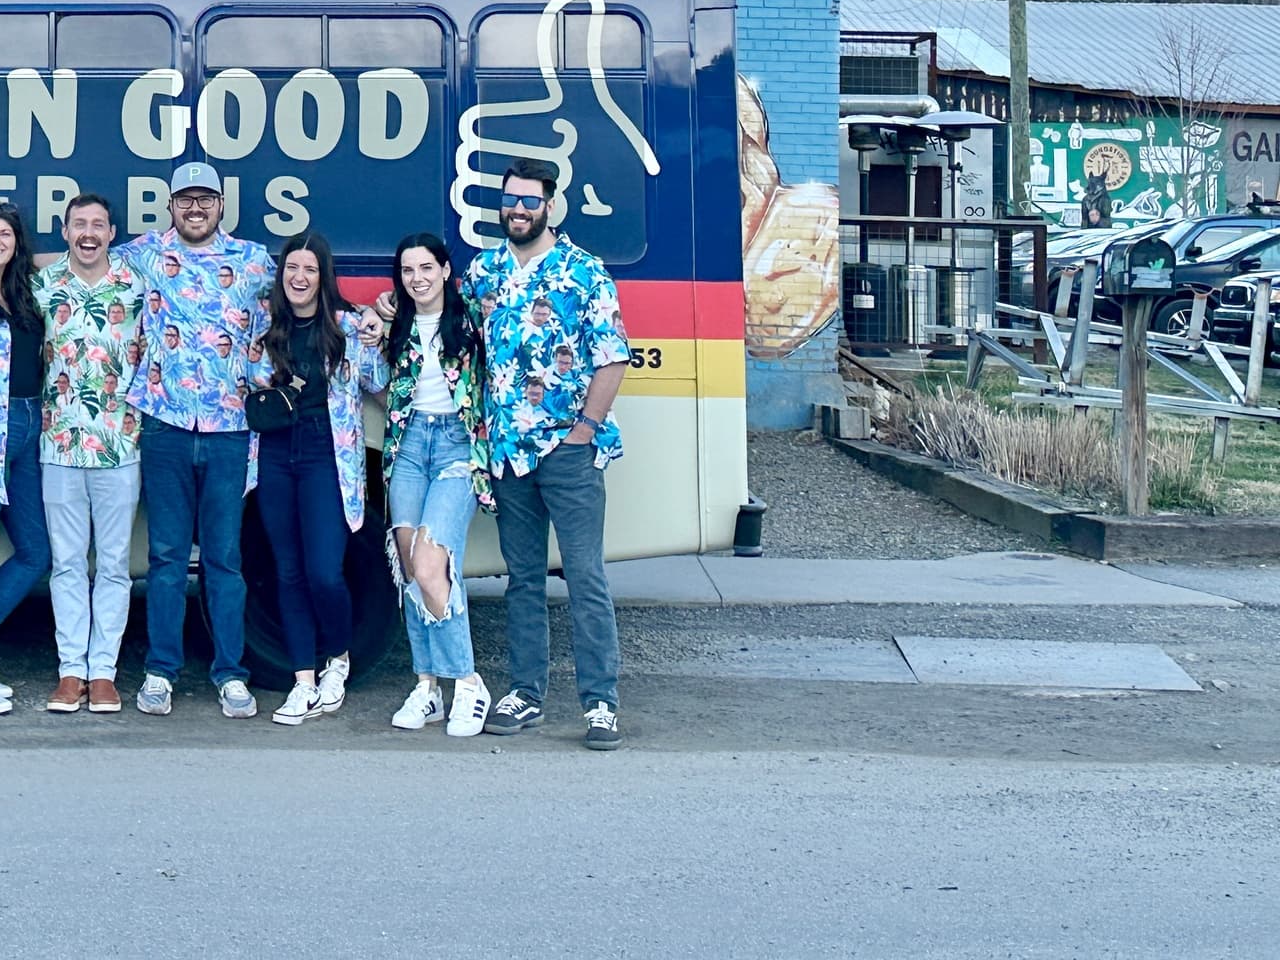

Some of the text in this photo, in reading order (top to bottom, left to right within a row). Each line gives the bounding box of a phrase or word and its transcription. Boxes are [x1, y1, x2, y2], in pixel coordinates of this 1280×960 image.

[121, 67, 430, 161] GOOD
[1232, 131, 1280, 162] GA
[189, 167, 201, 182] P
